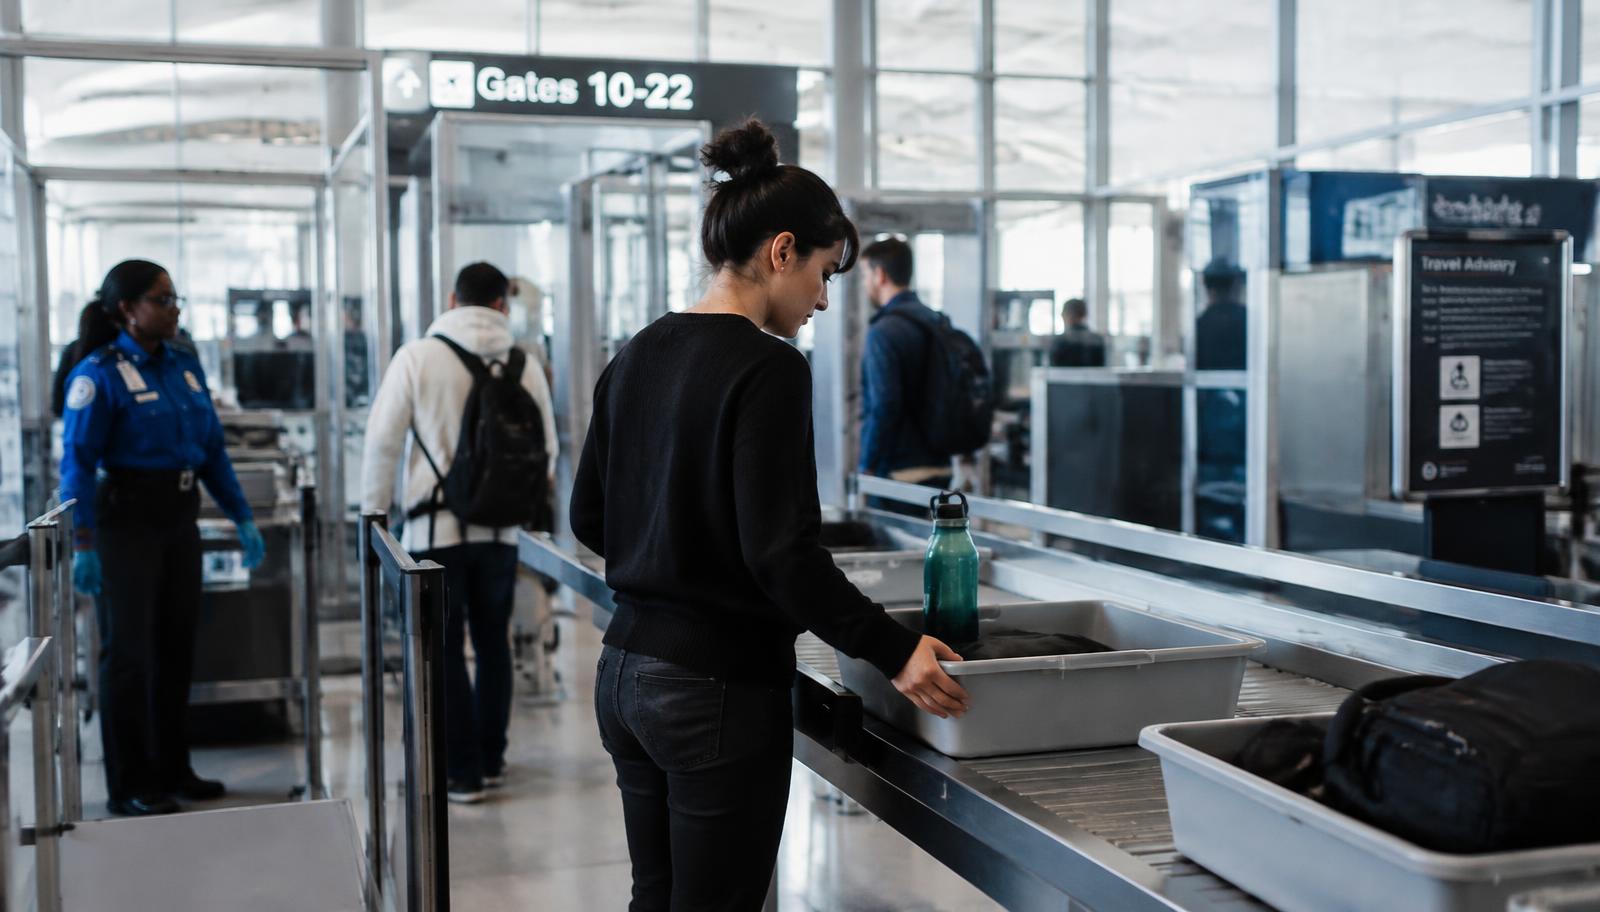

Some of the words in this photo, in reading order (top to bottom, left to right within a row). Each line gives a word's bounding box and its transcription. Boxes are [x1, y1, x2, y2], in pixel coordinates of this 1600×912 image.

[476, 67, 579, 104] Gates
[587, 71, 693, 110] 10-22
[1422, 256, 1461, 271] Travel
